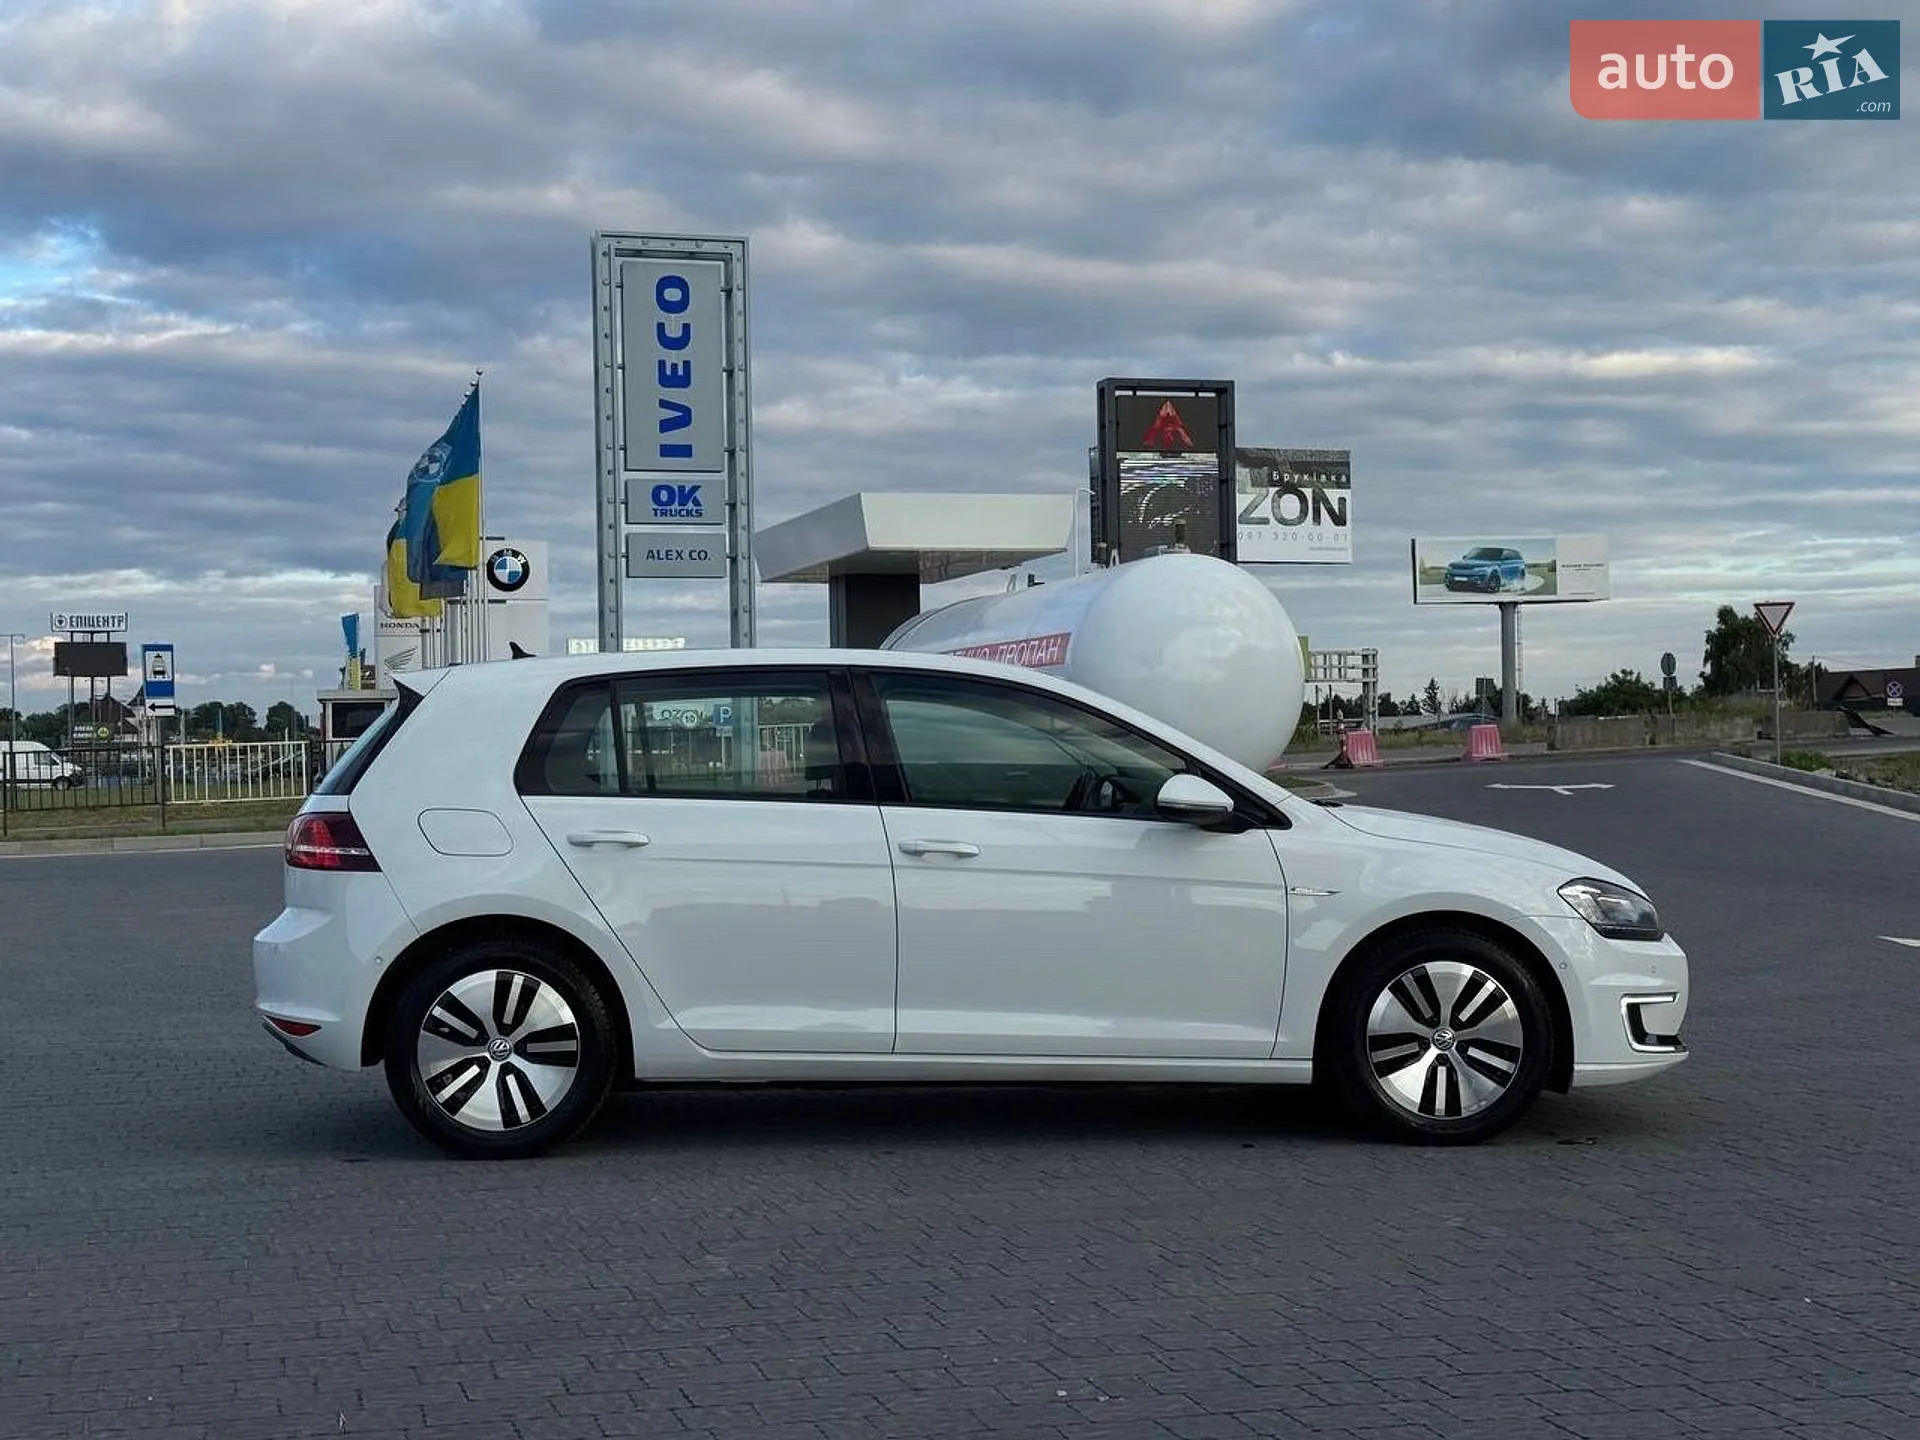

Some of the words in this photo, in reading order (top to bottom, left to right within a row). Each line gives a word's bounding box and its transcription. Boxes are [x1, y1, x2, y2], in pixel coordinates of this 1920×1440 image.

[656, 275, 692, 459] IVECO
[651, 484, 702, 507] OK
[652, 508, 703, 517] TRUCKS
[646, 549, 684, 561] ALEX
[688, 549, 711, 561] CO.
[69, 615, 124, 628] ЕПІЦЕНТР
[996, 638, 1061, 665] ПРОПАН
